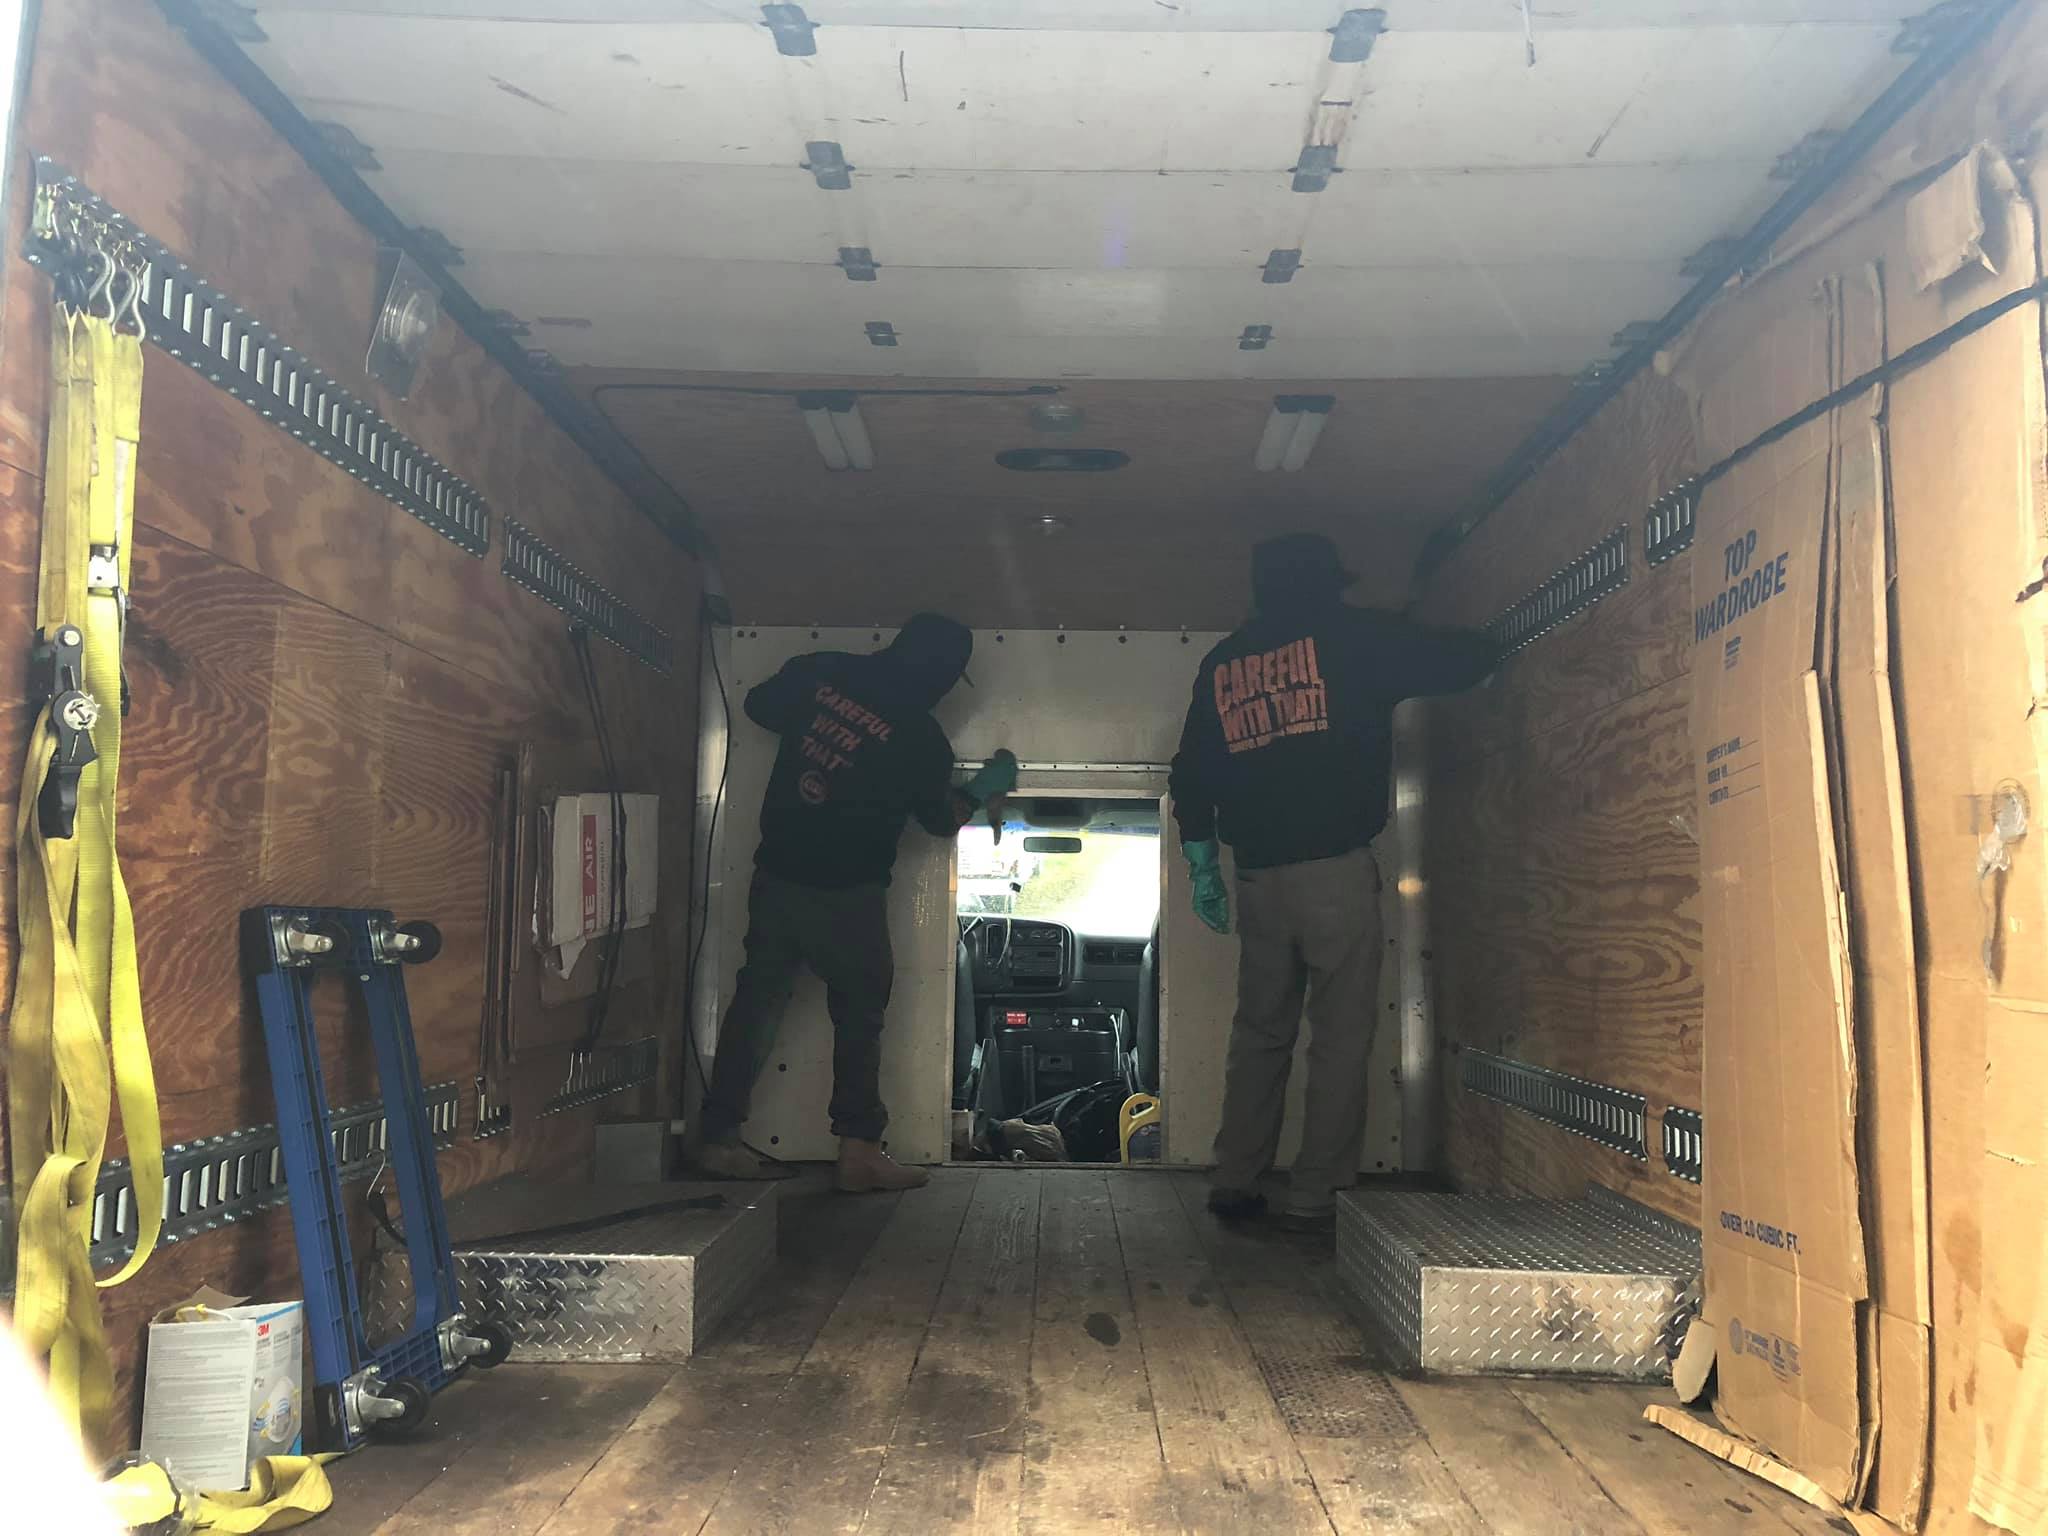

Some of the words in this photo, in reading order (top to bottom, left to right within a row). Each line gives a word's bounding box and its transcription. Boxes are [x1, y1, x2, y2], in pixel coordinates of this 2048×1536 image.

[1724, 529, 1757, 582] TOP
[1695, 551, 1789, 645] WARDROBE
[1214, 636, 1324, 713] CAREFUL
[811, 714, 862, 751] WITH
[815, 686, 892, 741] CAREFUL
[1219, 697, 1272, 742] WITH
[584, 837, 595, 879] AIR
[1719, 1211, 1741, 1232] OVER
[1756, 1223, 1785, 1249] CUBIC
[1785, 1232, 1802, 1255] FT.
[257, 1323, 270, 1337] 3M
